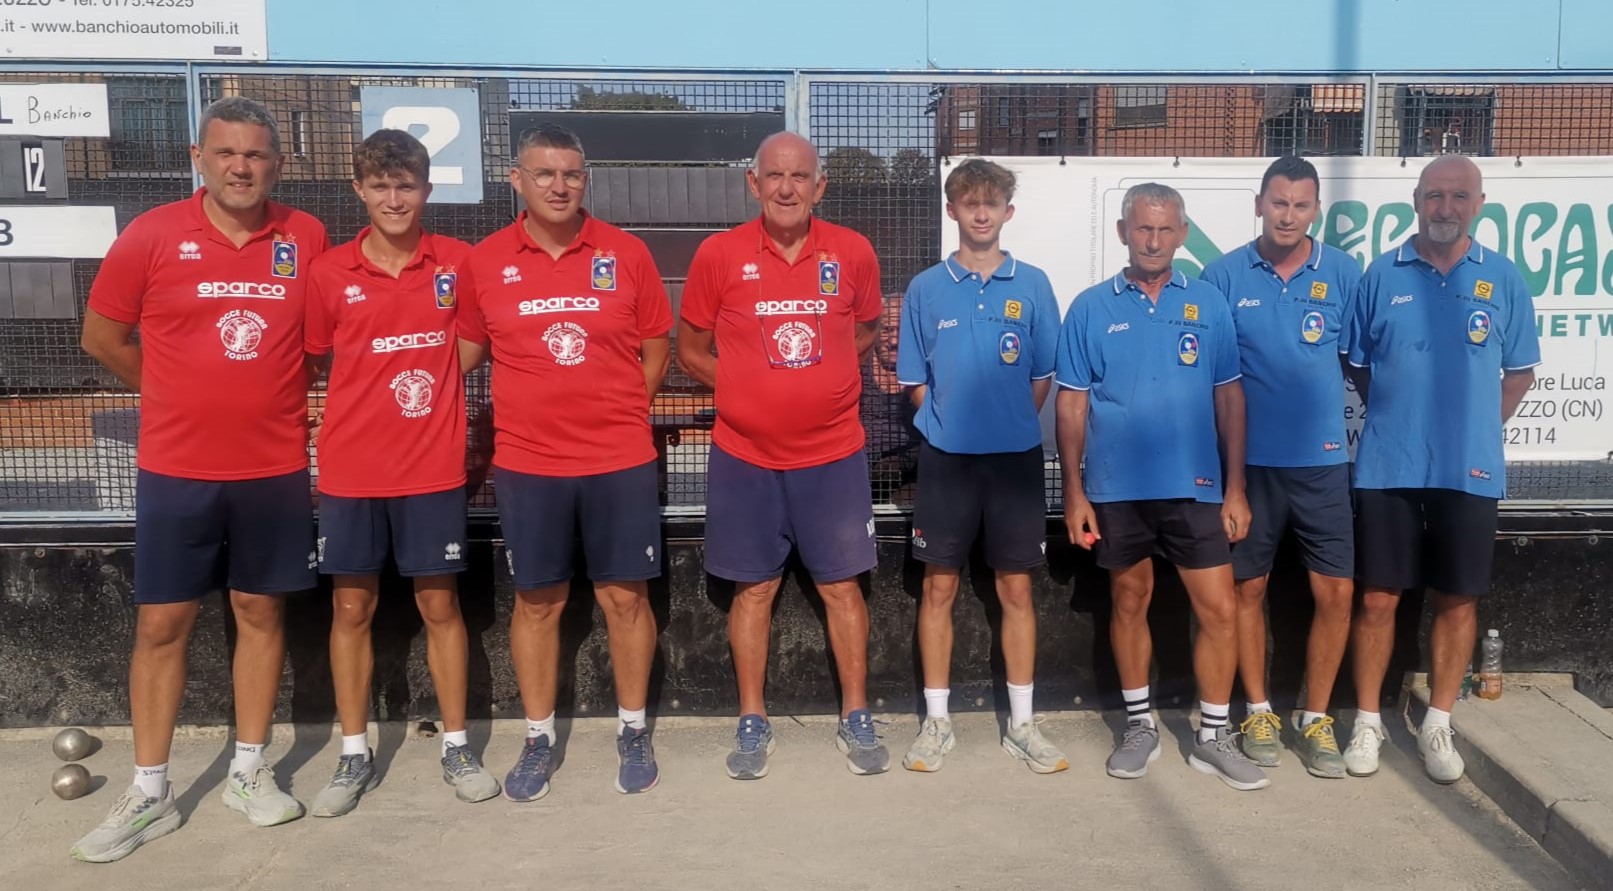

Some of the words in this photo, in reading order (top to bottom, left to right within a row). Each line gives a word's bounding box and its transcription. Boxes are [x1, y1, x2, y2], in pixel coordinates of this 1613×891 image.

[31, 20, 239, 35] www.banchioautomobili.it
[382, 106, 463, 184] 2
[24, 147, 47, 192] 12
[197, 282, 286, 300] sparco
[518, 297, 600, 315] sparco
[755, 300, 828, 316] sparco
[216, 309, 241, 328] BOCCE
[243, 309, 268, 330] FUTURA
[541, 322, 562, 341] BOCCE
[772, 322, 793, 340] BOCCE
[372, 331, 446, 353] sparco
[224, 349, 258, 361] TORINO
[555, 355, 585, 366] TORINO
[389, 370, 412, 390] BOCCE
[1560, 373, 1606, 391] Luca
[401, 406, 432, 418] TORINO
[1561, 398, 1603, 422] (CN)
